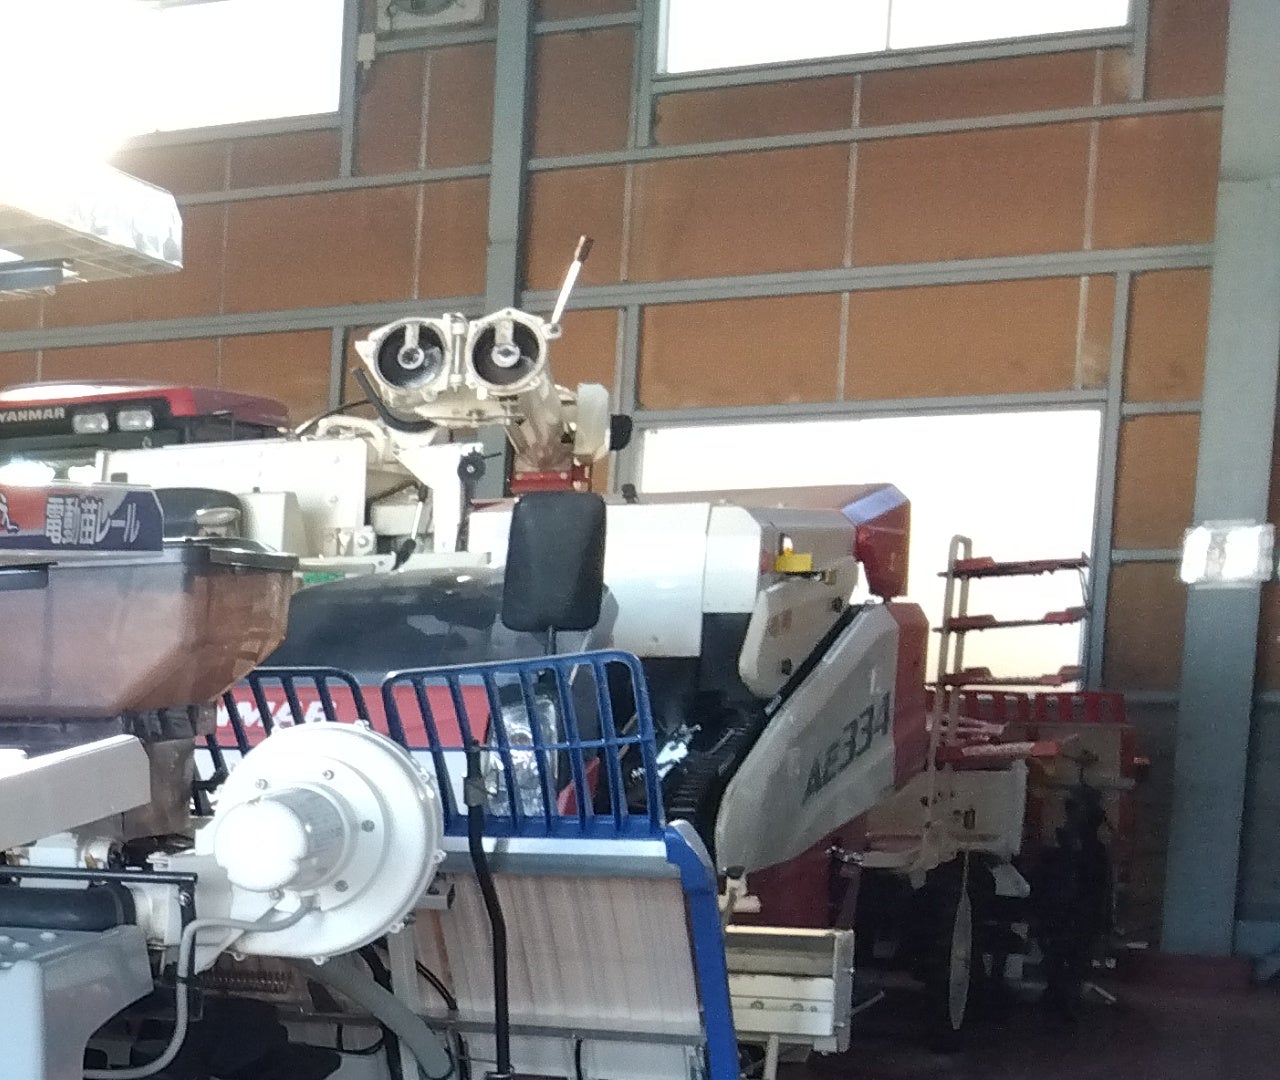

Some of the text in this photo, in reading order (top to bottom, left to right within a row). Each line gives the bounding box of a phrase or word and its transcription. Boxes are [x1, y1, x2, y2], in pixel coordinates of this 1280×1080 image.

[45, 494, 142, 546] 電動苗レール
